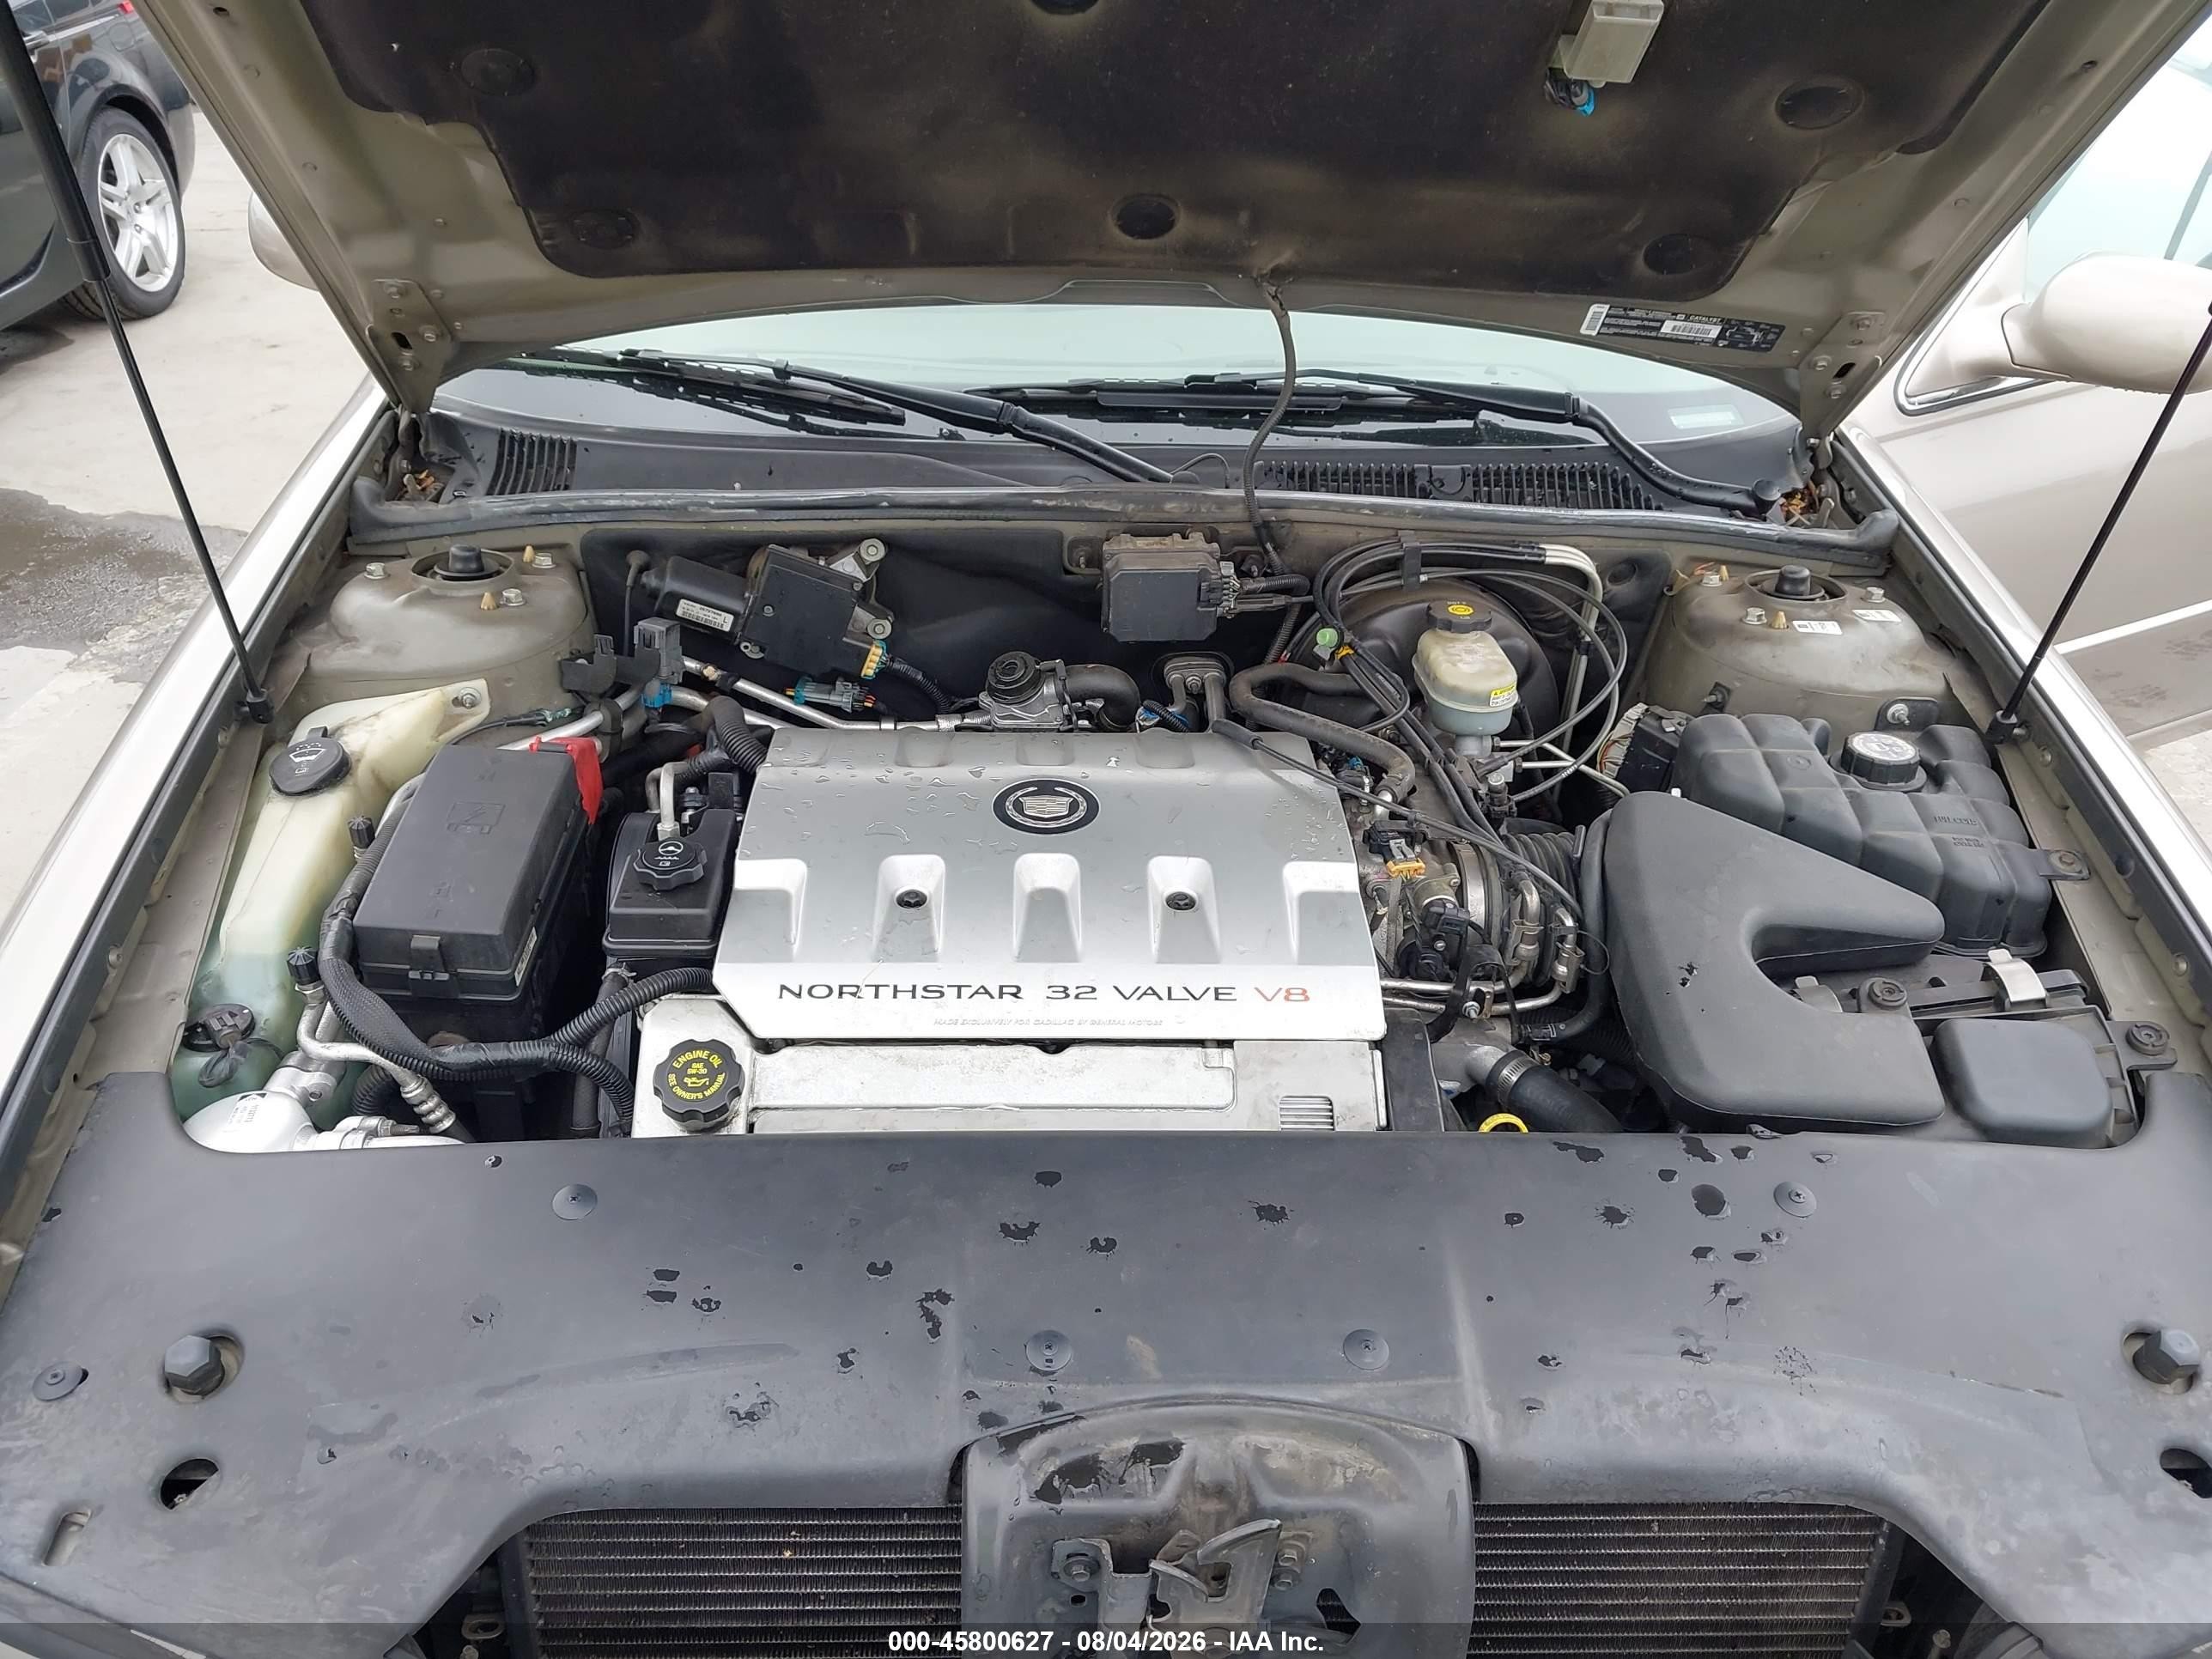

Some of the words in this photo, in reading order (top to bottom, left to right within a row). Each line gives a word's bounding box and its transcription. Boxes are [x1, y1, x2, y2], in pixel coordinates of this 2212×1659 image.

[1689, 314, 1723, 324] CATALYST
[778, 984, 1024, 1000] NORTHSTAR
[1045, 985, 1097, 1000] 32
[1113, 985, 1237, 1001] VALVE
[1254, 987, 1310, 1002] V8
[672, 1050, 710, 1069] ENGINE
[709, 1054, 723, 1068] OIL
[668, 1073, 678, 1086] SEE
[703, 1073, 726, 1097] MANUAL
[672, 1086, 703, 1099] OWNER'S
